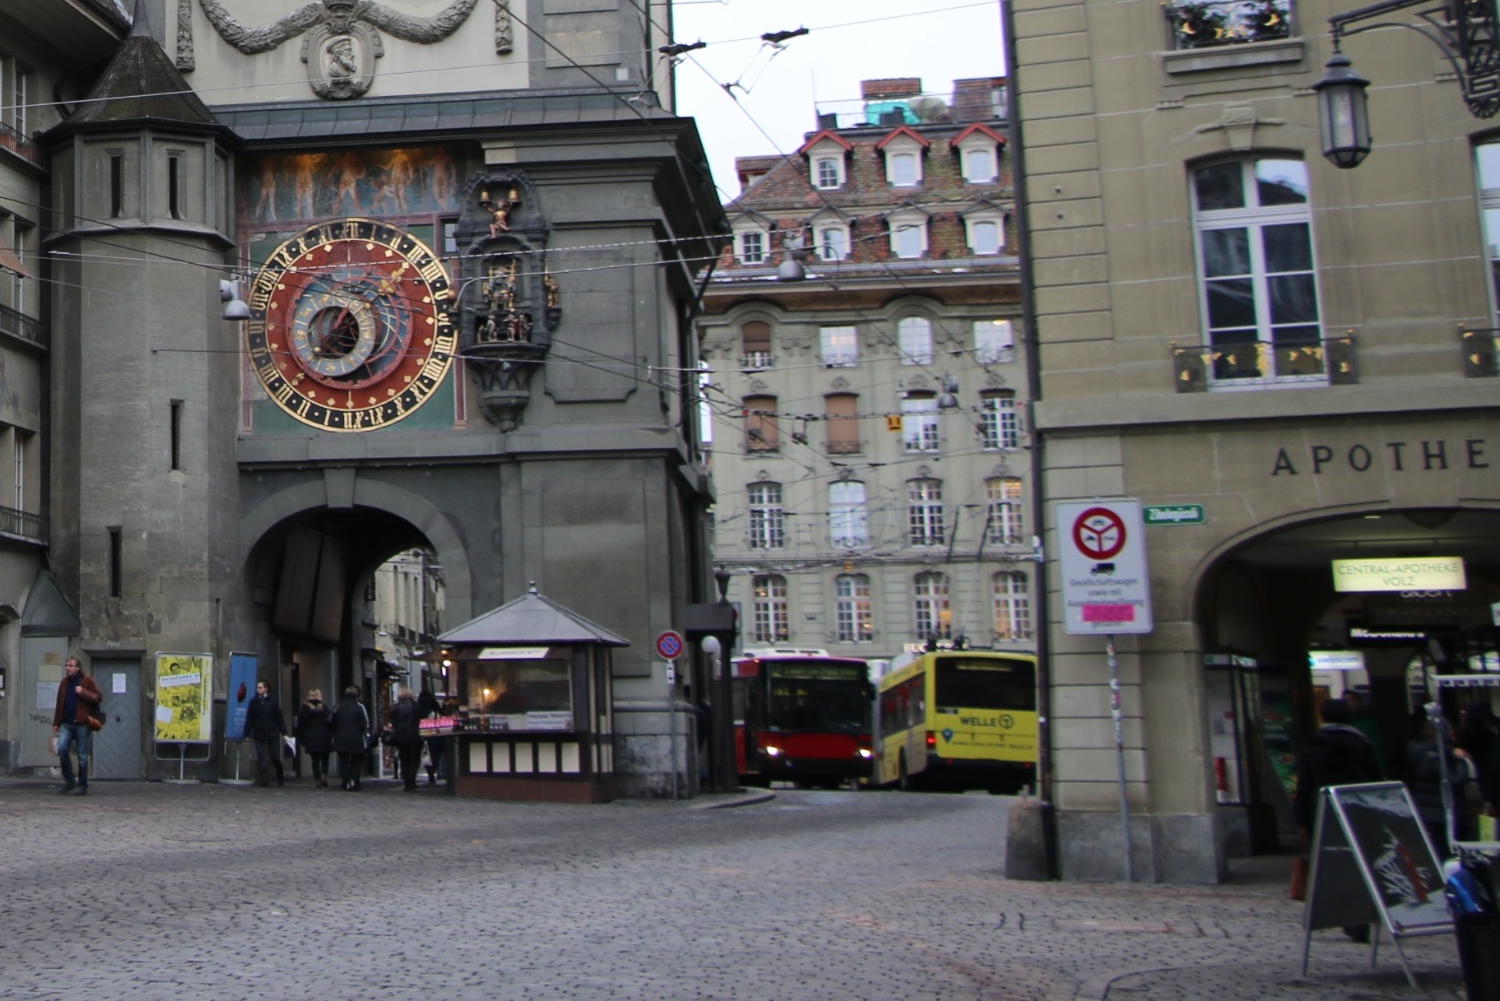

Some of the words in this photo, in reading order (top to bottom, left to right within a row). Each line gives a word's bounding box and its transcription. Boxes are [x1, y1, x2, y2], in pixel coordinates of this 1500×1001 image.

[1271, 439, 1490, 476] APOTHE
[1337, 562, 1460, 576] CENTRAL-APOTHEKE
[1382, 576, 1415, 587] VOLZ
[959, 717, 997, 728] WELLE
